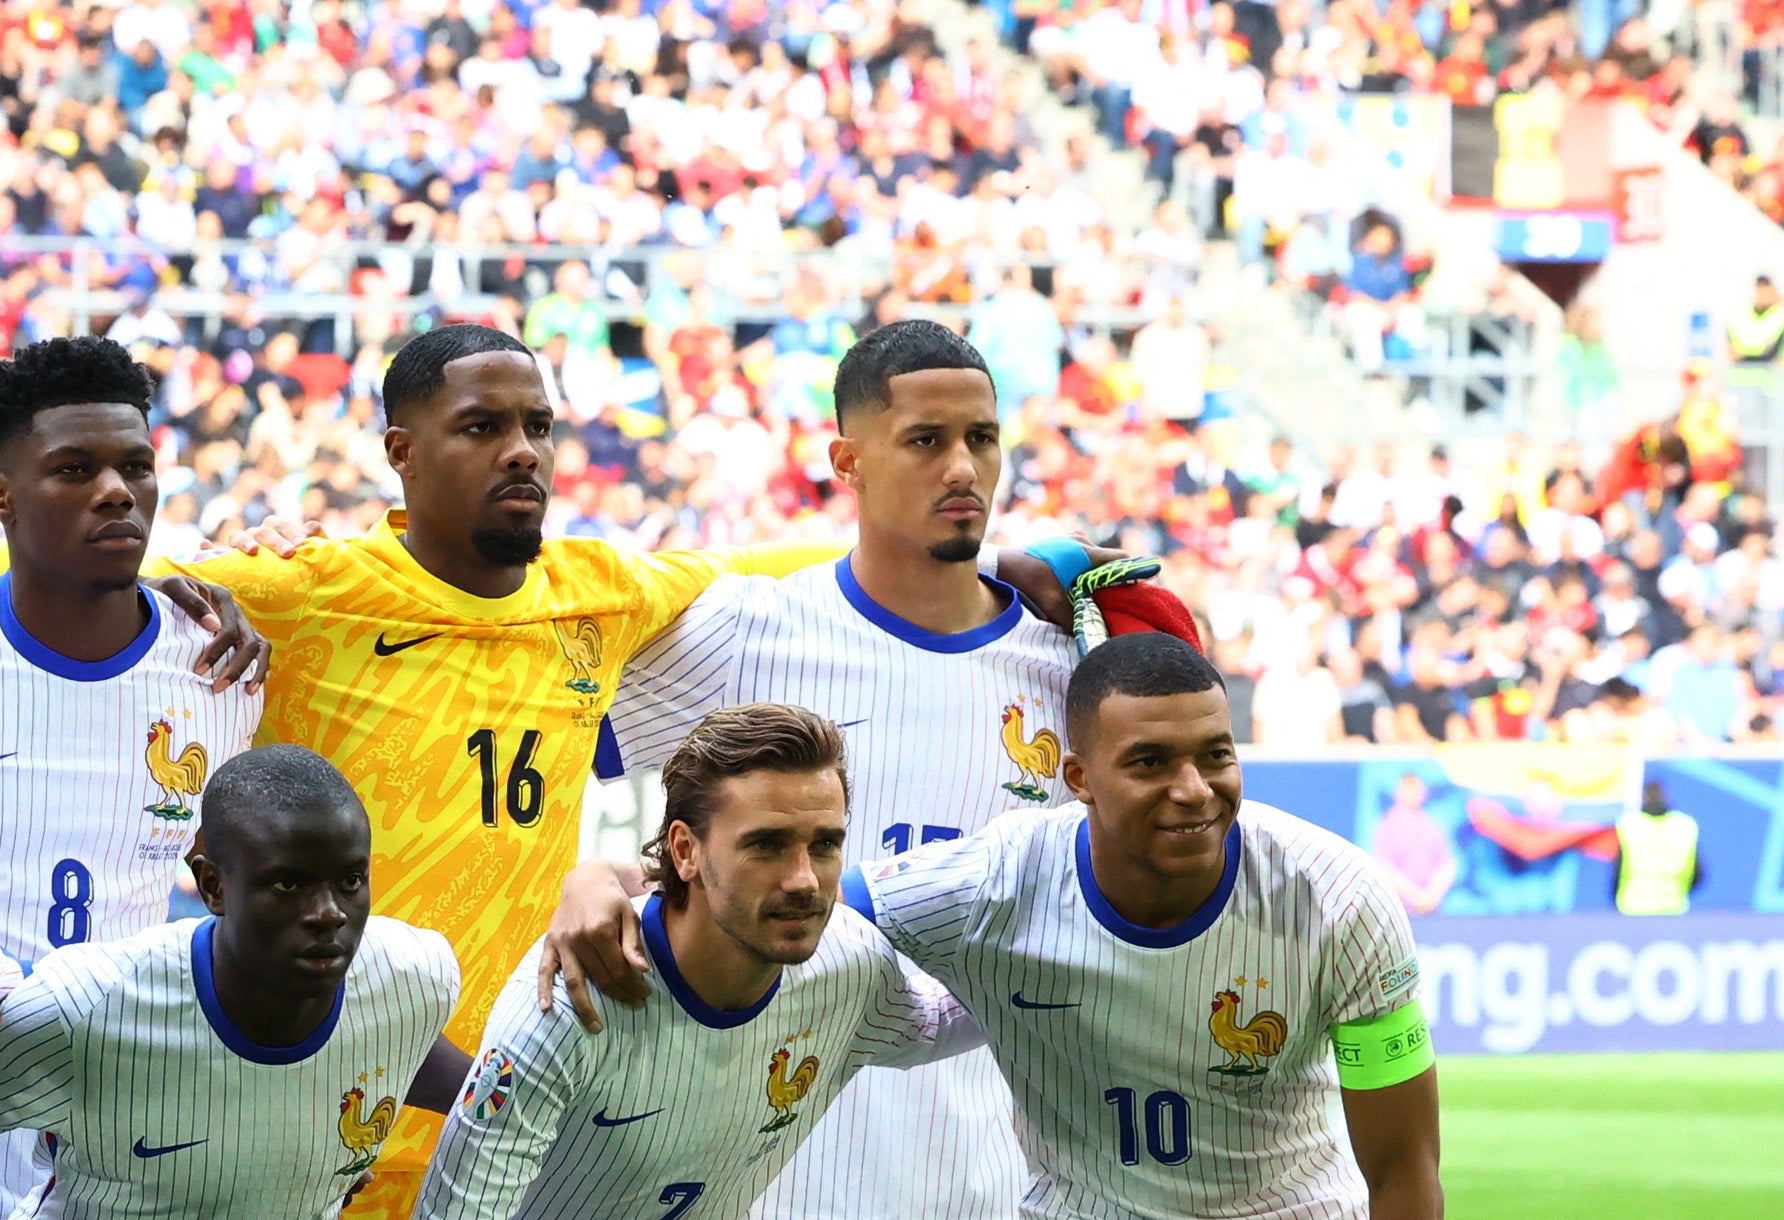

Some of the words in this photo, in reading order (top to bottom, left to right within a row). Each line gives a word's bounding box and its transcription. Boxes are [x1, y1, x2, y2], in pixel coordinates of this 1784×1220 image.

[467, 729, 545, 828] 16
[47, 858, 94, 949] 8
[1104, 1086, 1192, 1167] 10
